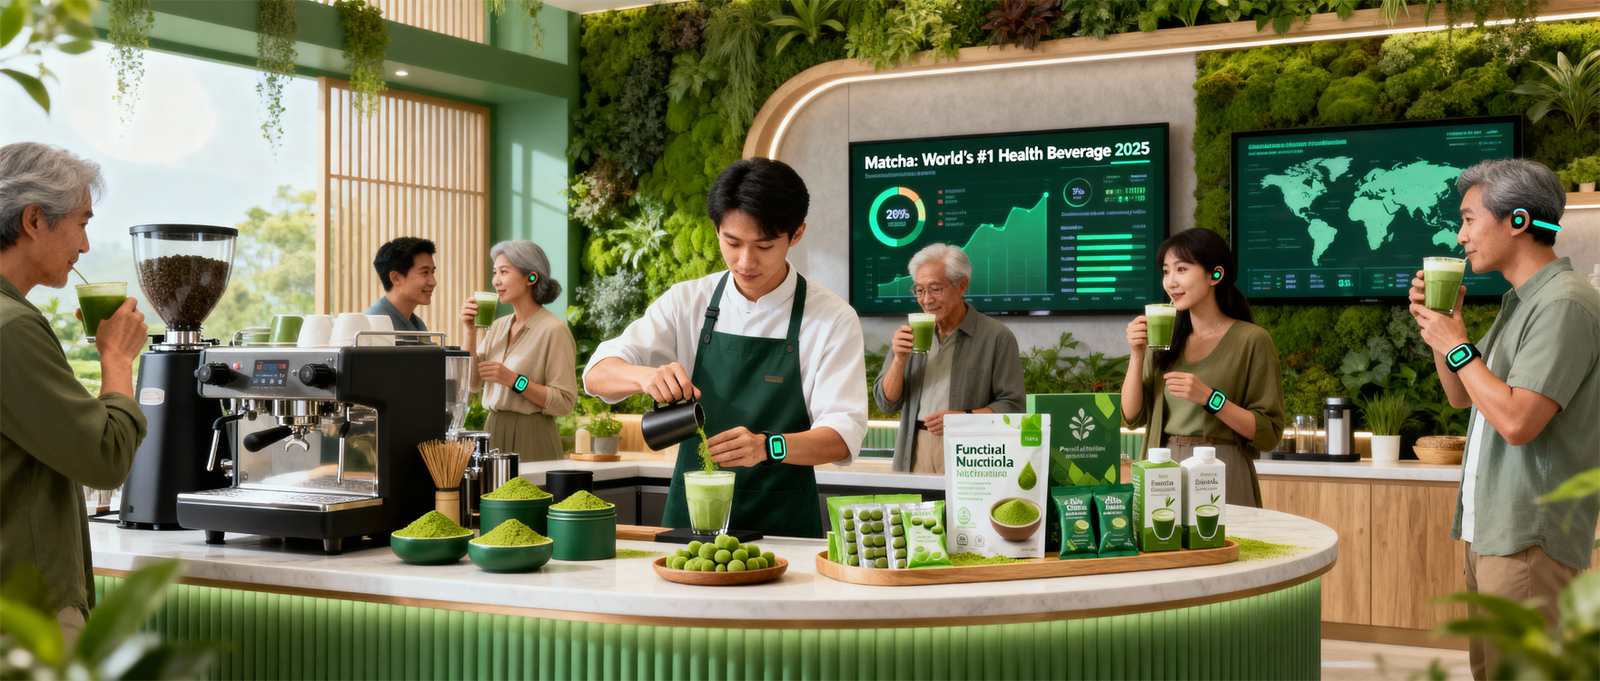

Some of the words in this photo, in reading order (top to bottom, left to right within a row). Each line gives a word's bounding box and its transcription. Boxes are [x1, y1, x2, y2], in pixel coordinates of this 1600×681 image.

[864, 154, 918, 170] Matcha:
[922, 149, 974, 167] World's
[977, 150, 994, 164] #1
[998, 146, 1043, 162] Health
[1047, 143, 1112, 161] Beverage
[1114, 141, 1150, 157] 2025
